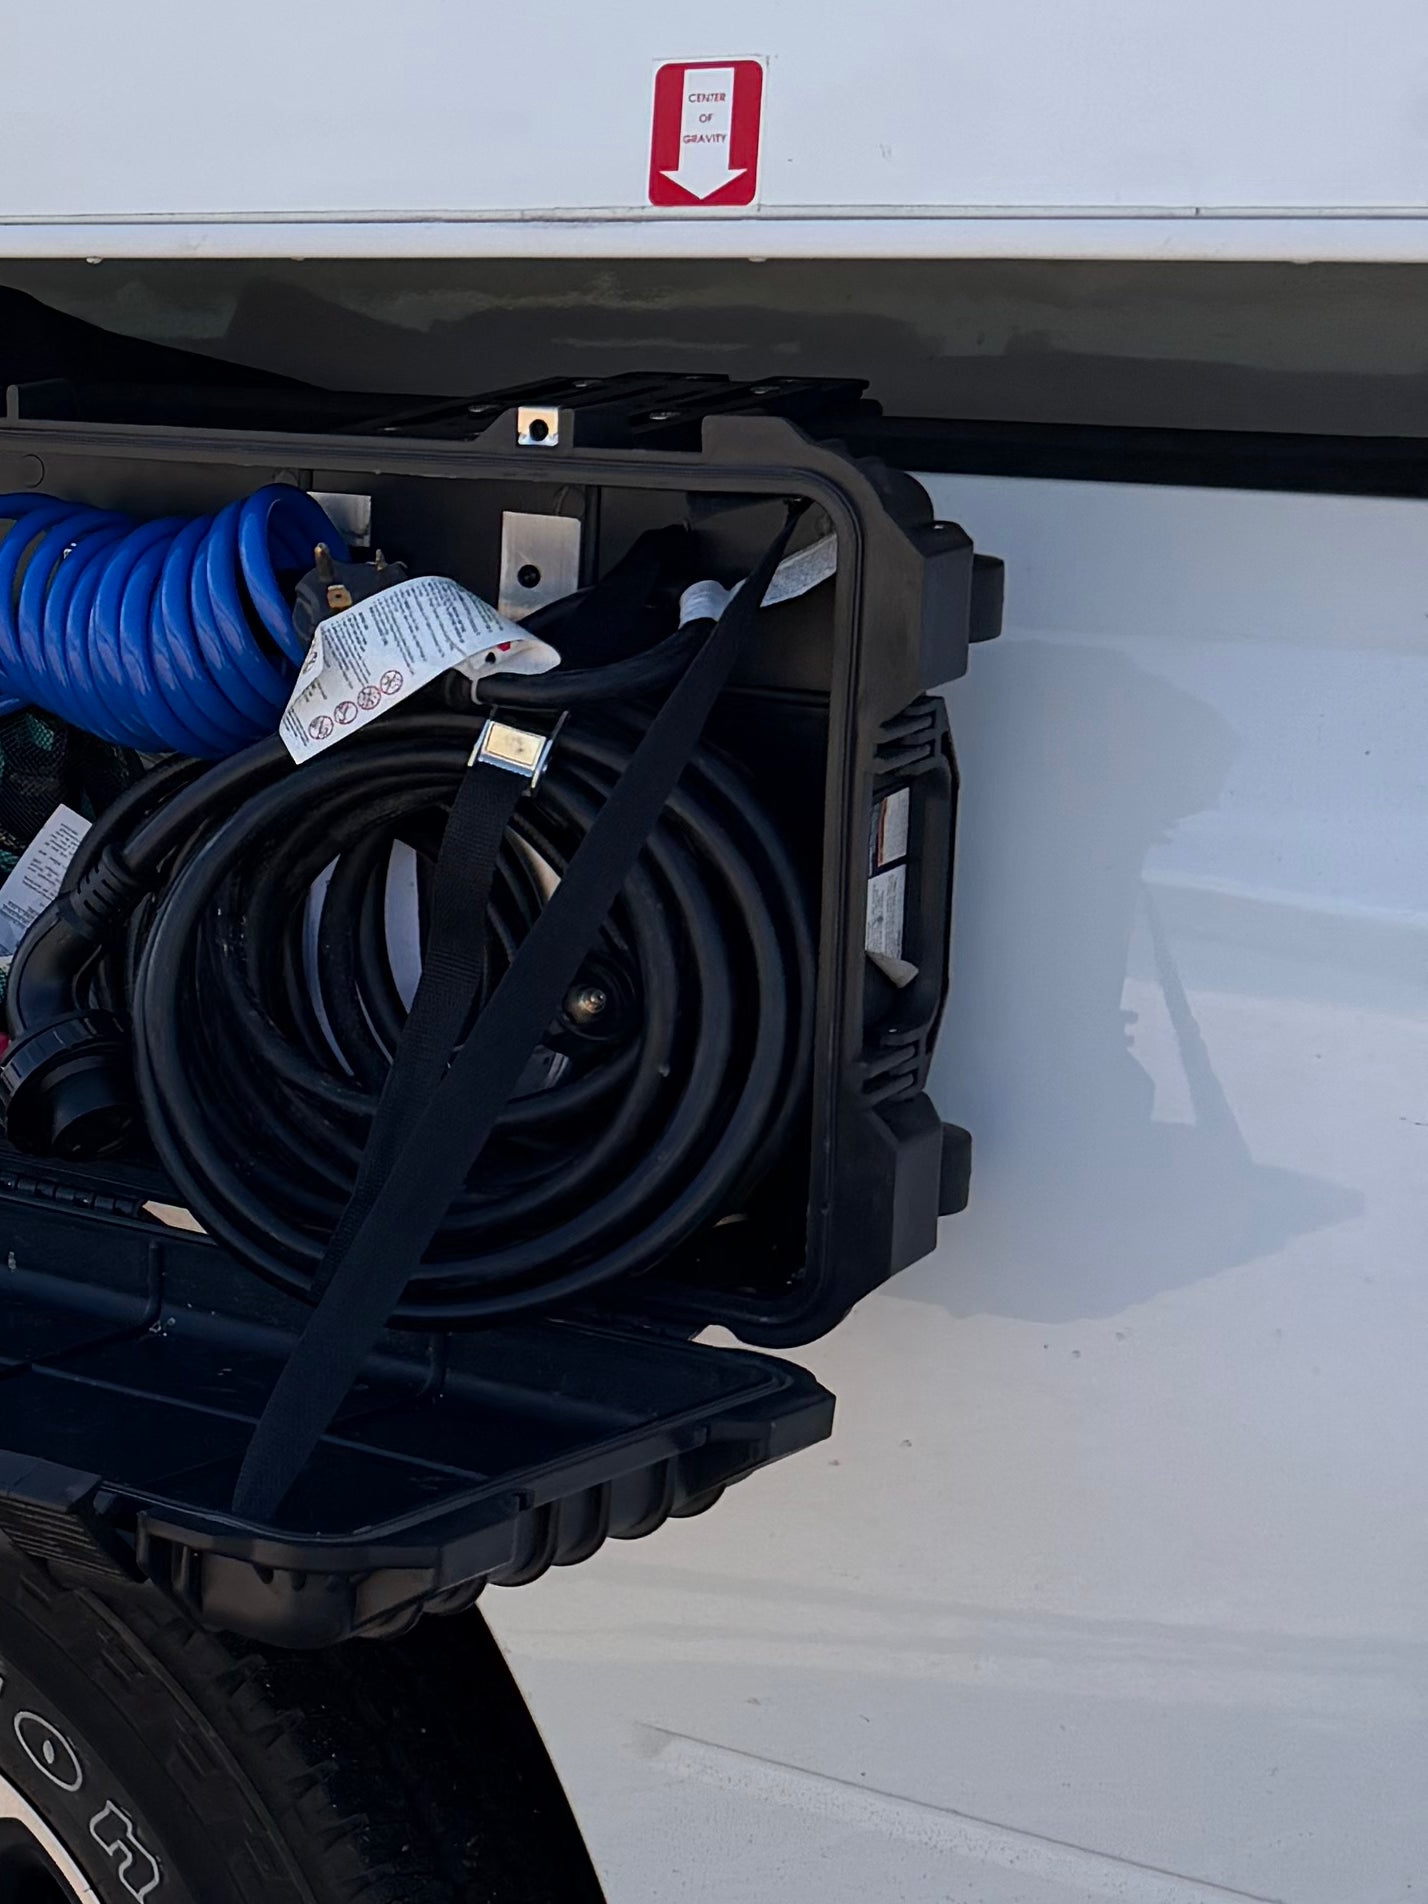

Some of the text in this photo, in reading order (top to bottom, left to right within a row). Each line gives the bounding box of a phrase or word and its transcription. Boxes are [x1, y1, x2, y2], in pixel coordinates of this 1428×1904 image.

[688, 93, 726, 103] CENTER
[699, 113, 713, 123] OF
[683, 134, 727, 144] GRAVITY
